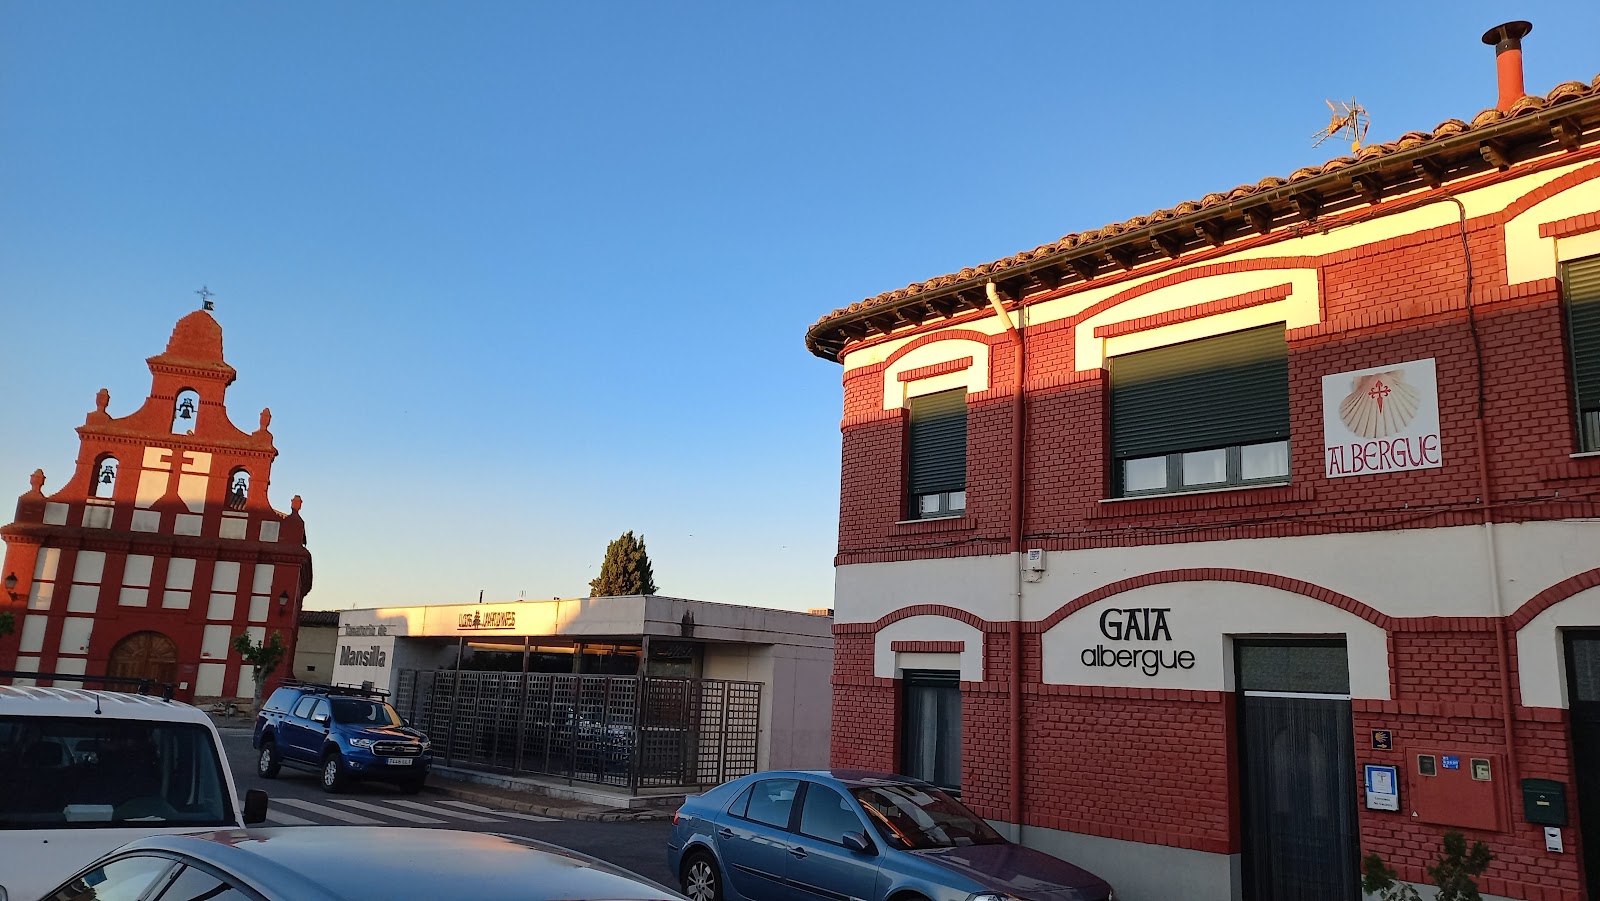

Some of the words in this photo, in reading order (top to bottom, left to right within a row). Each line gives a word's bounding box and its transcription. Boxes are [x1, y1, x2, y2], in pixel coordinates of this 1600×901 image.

[1328, 435, 1438, 475] ALBERGUE
[1099, 608, 1172, 641] GAIA
[340, 645, 386, 667] Mansilla
[1081, 645, 1195, 677] albergue
